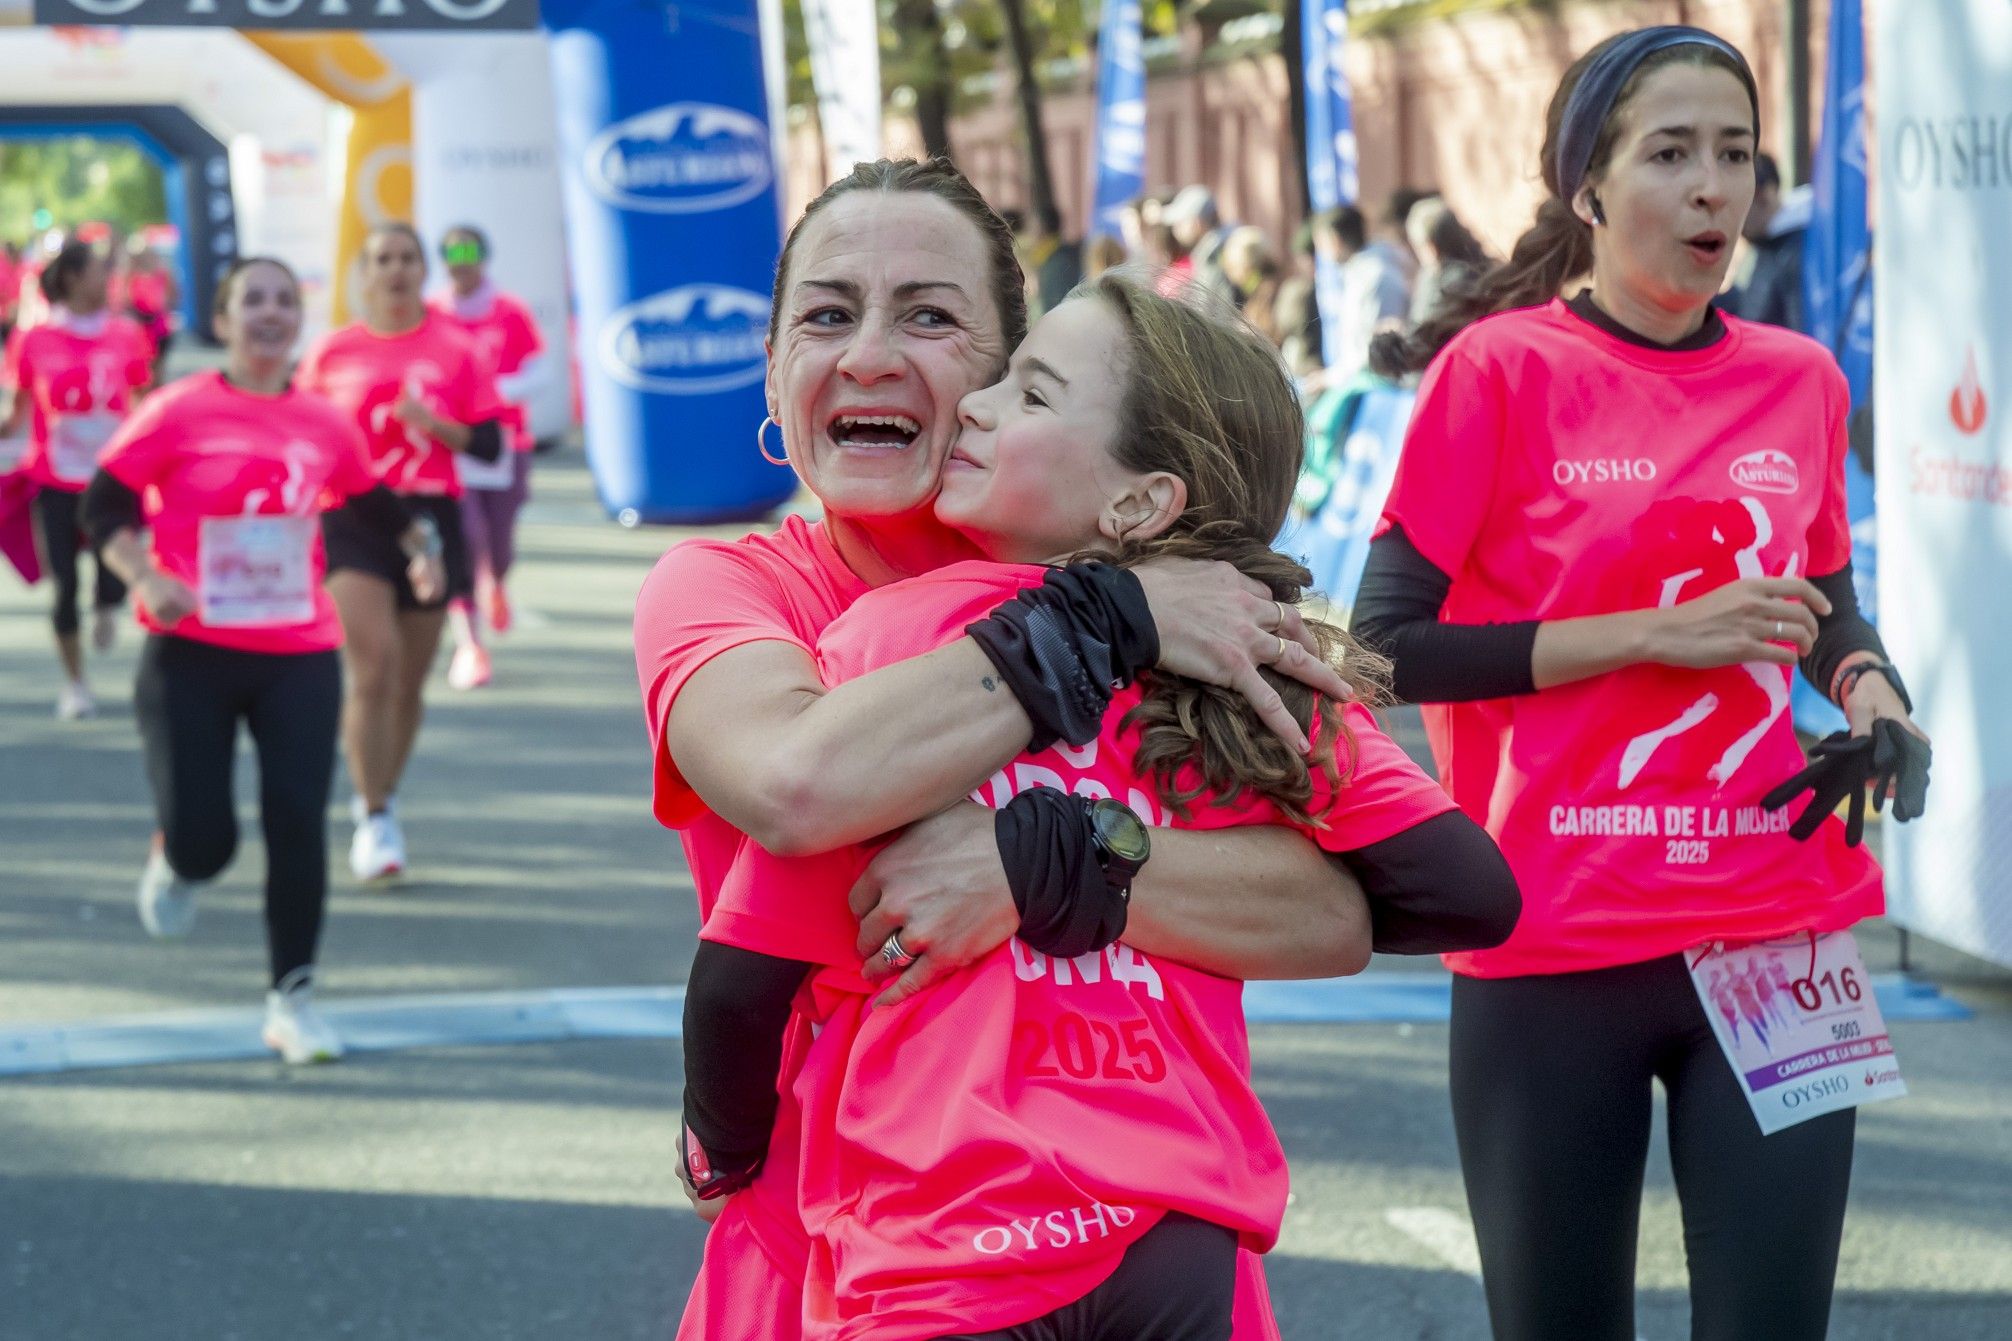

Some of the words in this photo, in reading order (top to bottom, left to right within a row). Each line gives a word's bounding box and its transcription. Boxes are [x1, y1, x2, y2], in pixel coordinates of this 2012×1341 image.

[1553, 458, 1656, 485] OYSHO
[1550, 805, 1659, 836] CARRERA
[1664, 806, 1695, 836] DE
[1702, 806, 1729, 837] LA
[1735, 805, 1790, 835] MUJER
[1665, 840, 1710, 864] 2025
[1791, 966, 1861, 1012] 016
[1013, 1011, 1167, 1083] 2025
[1782, 1074, 1848, 1108] OYSHO
[973, 1202, 1135, 1254] OYSHO
